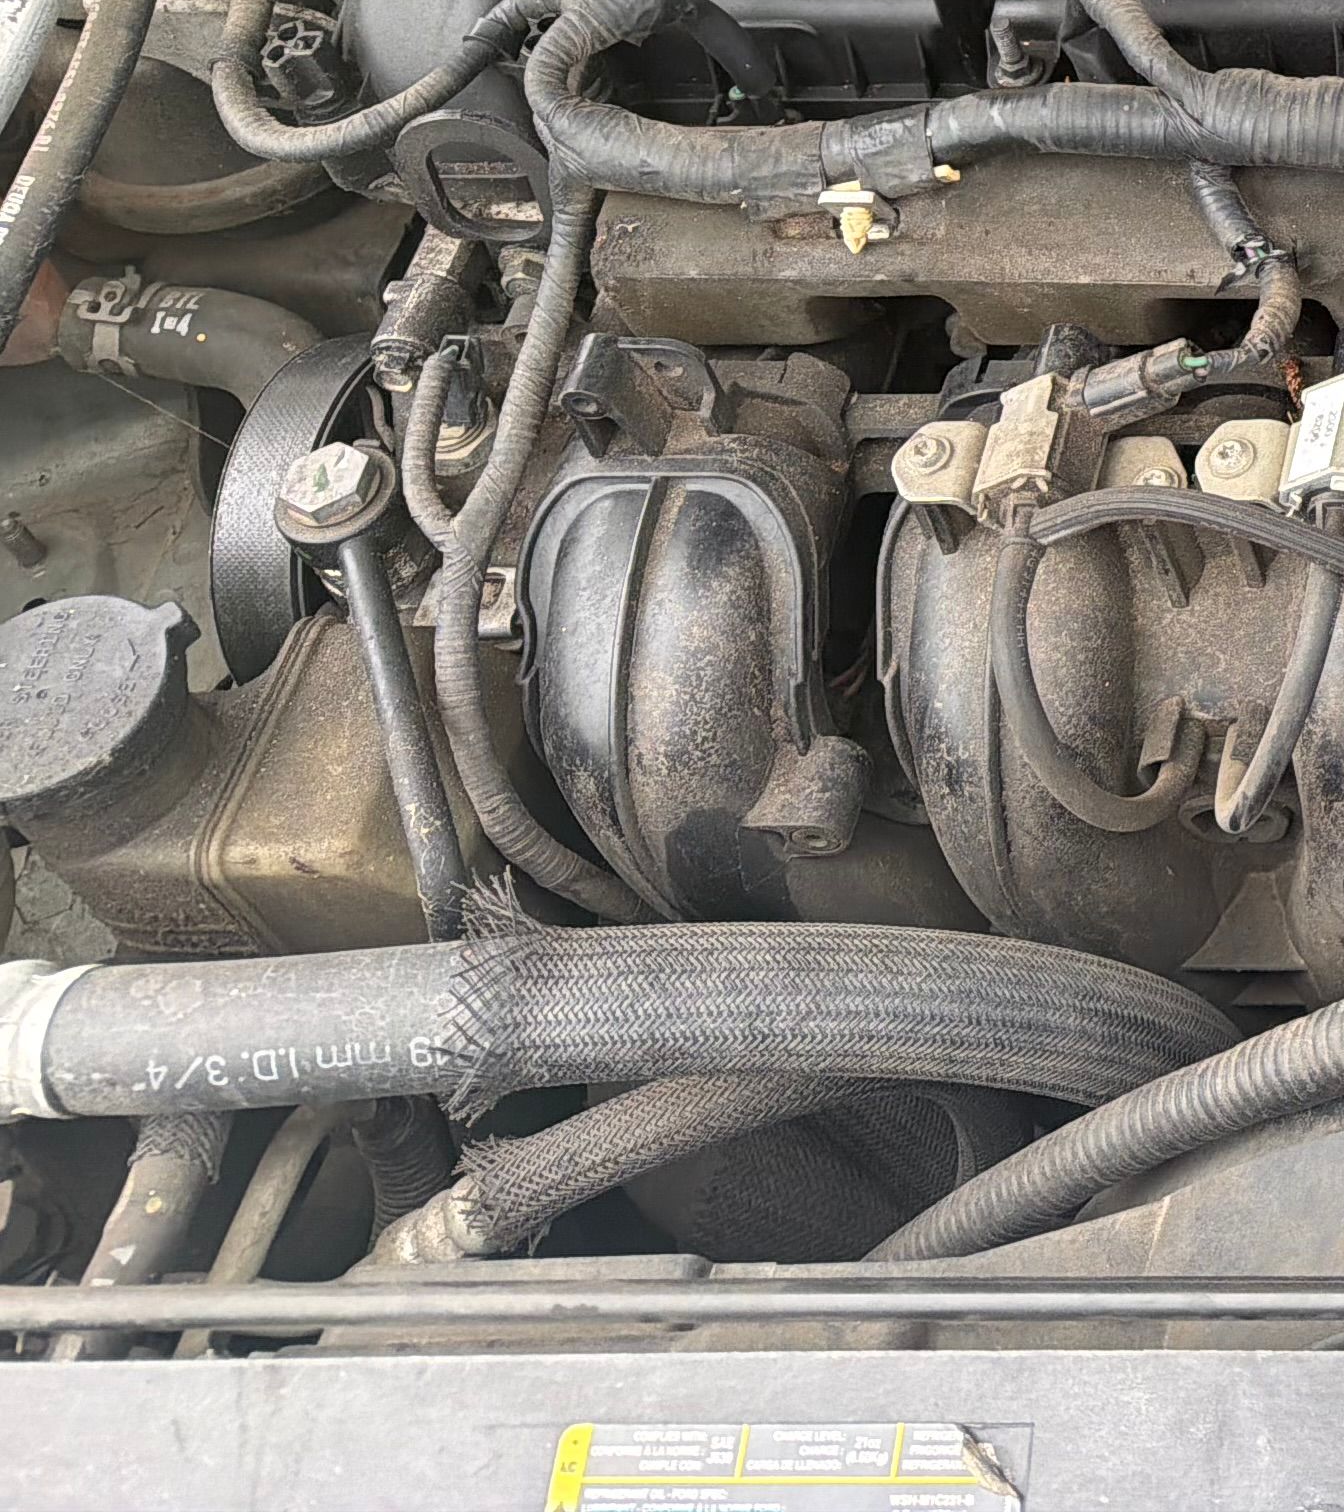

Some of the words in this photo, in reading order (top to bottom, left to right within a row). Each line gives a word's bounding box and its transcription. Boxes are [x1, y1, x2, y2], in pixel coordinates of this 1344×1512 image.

[12, 610, 70, 704] STEERING
[63, 634, 101, 682] ONLY
[315, 1041, 393, 1070] mm
[408, 1035, 450, 1068] 19
